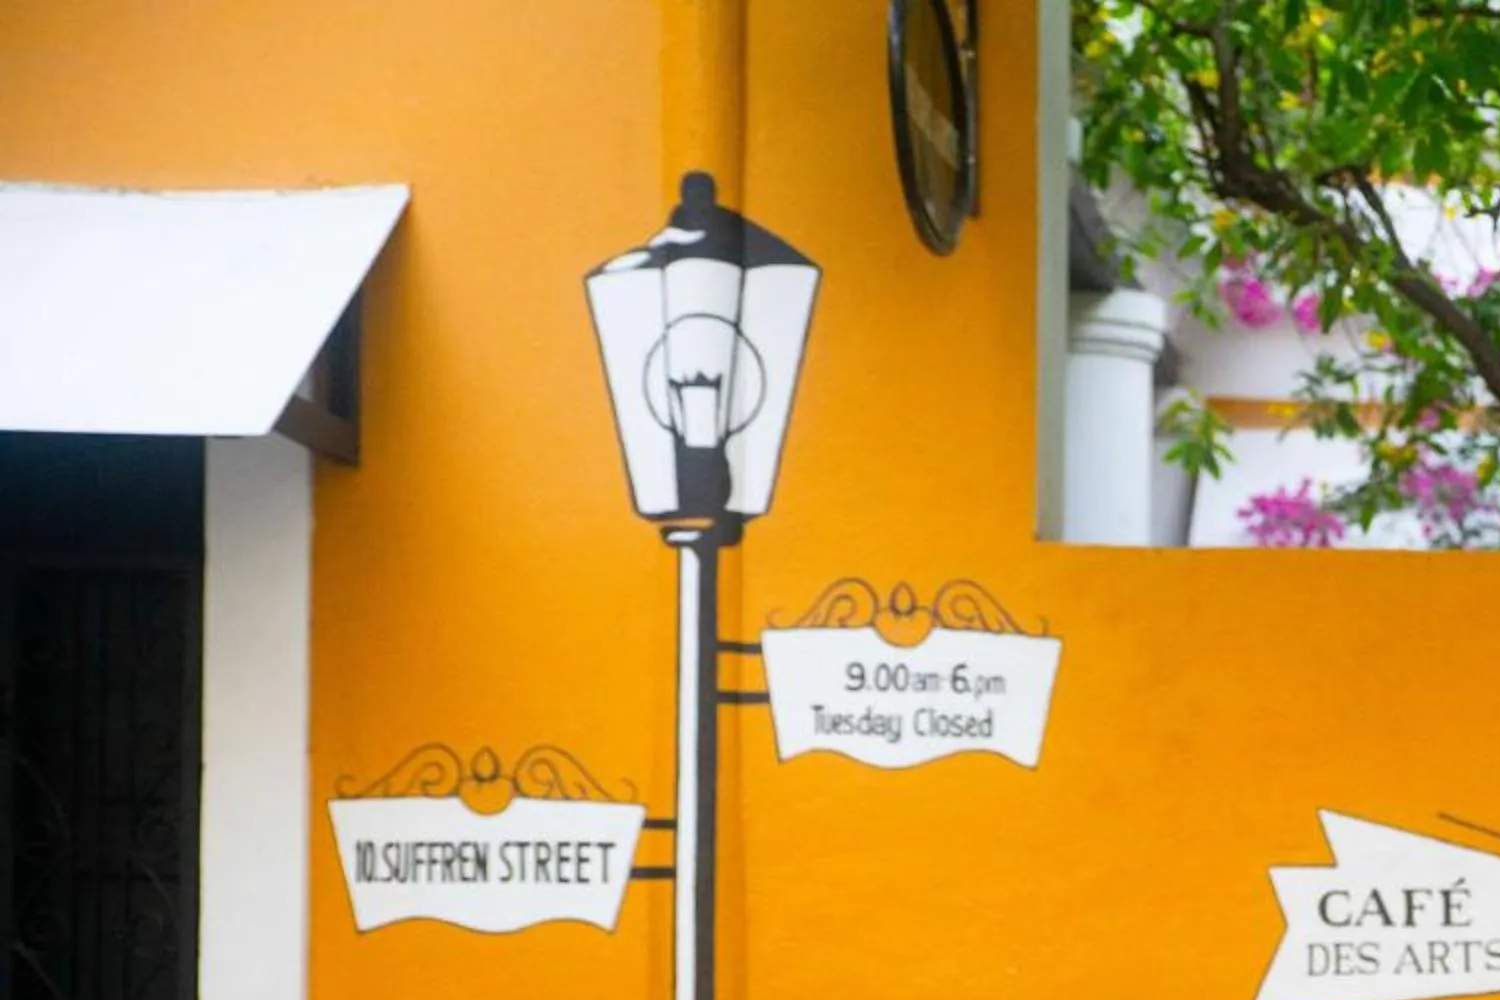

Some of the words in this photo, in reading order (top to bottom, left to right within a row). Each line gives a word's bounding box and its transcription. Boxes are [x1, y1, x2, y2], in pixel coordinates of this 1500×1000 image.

[811, 705, 902, 743] Tuesday
[913, 708, 993, 738] Closed
[498, 841, 615, 883] STREET
[1318, 877, 1473, 927] CAFÉ
[1307, 942, 1381, 977] DES
